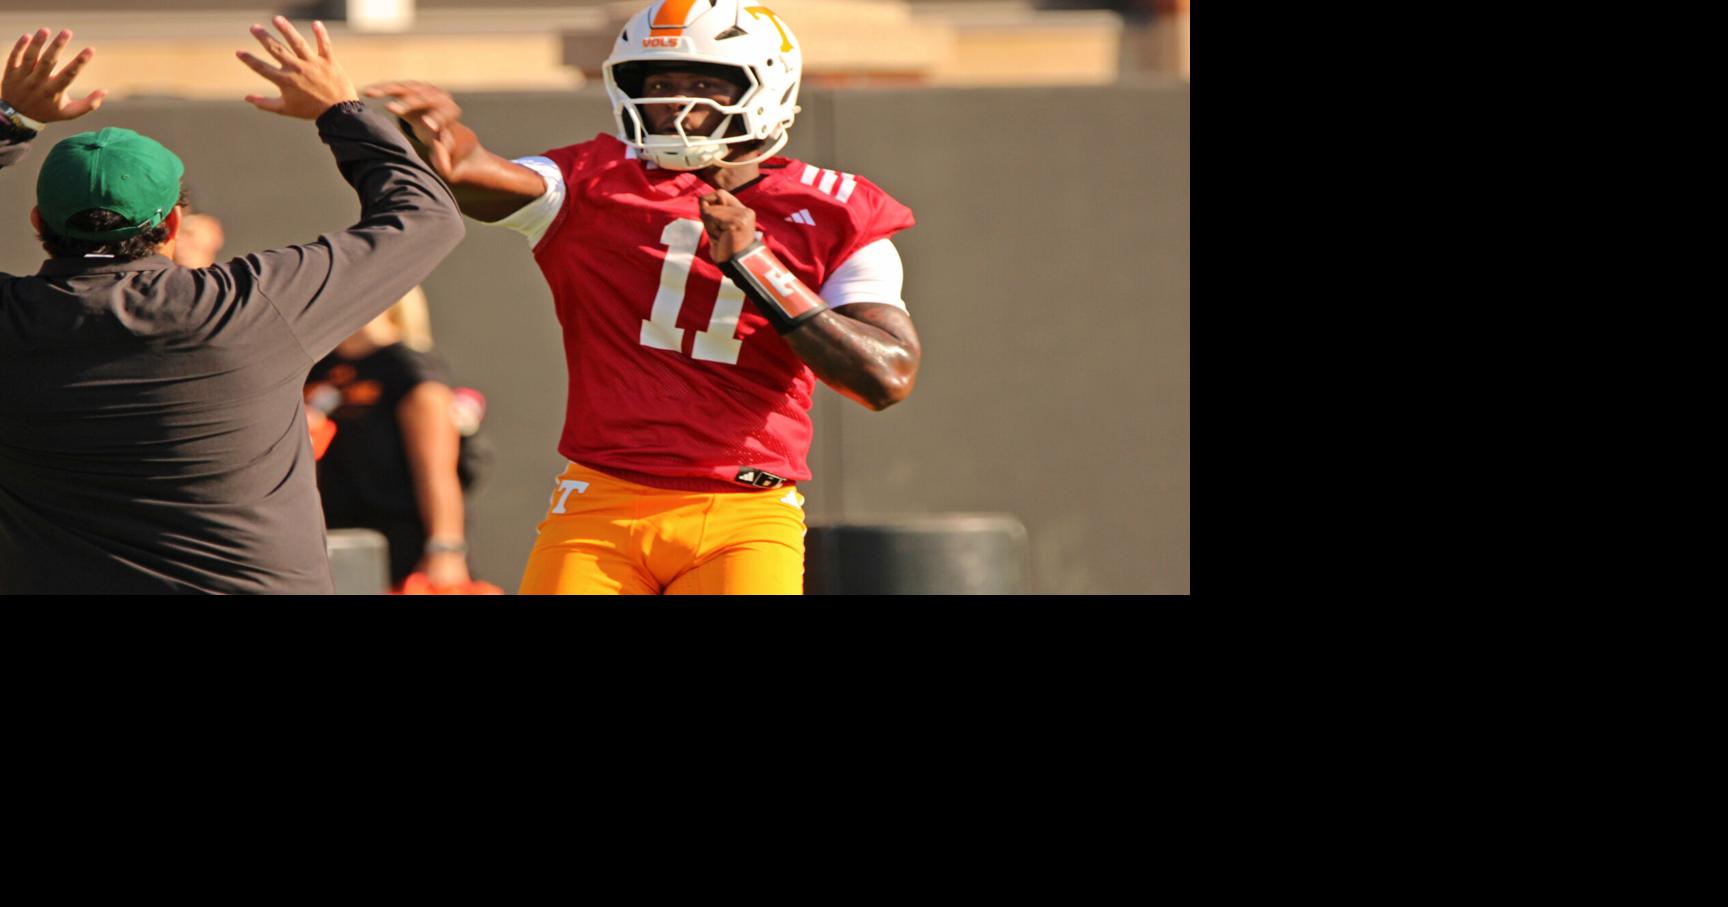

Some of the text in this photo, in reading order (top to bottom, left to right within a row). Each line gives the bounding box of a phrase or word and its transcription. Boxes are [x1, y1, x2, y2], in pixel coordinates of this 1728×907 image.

[642, 37, 679, 48] VOLS
[744, 6, 794, 53] T
[639, 217, 763, 366] 11
[552, 479, 589, 514] T
